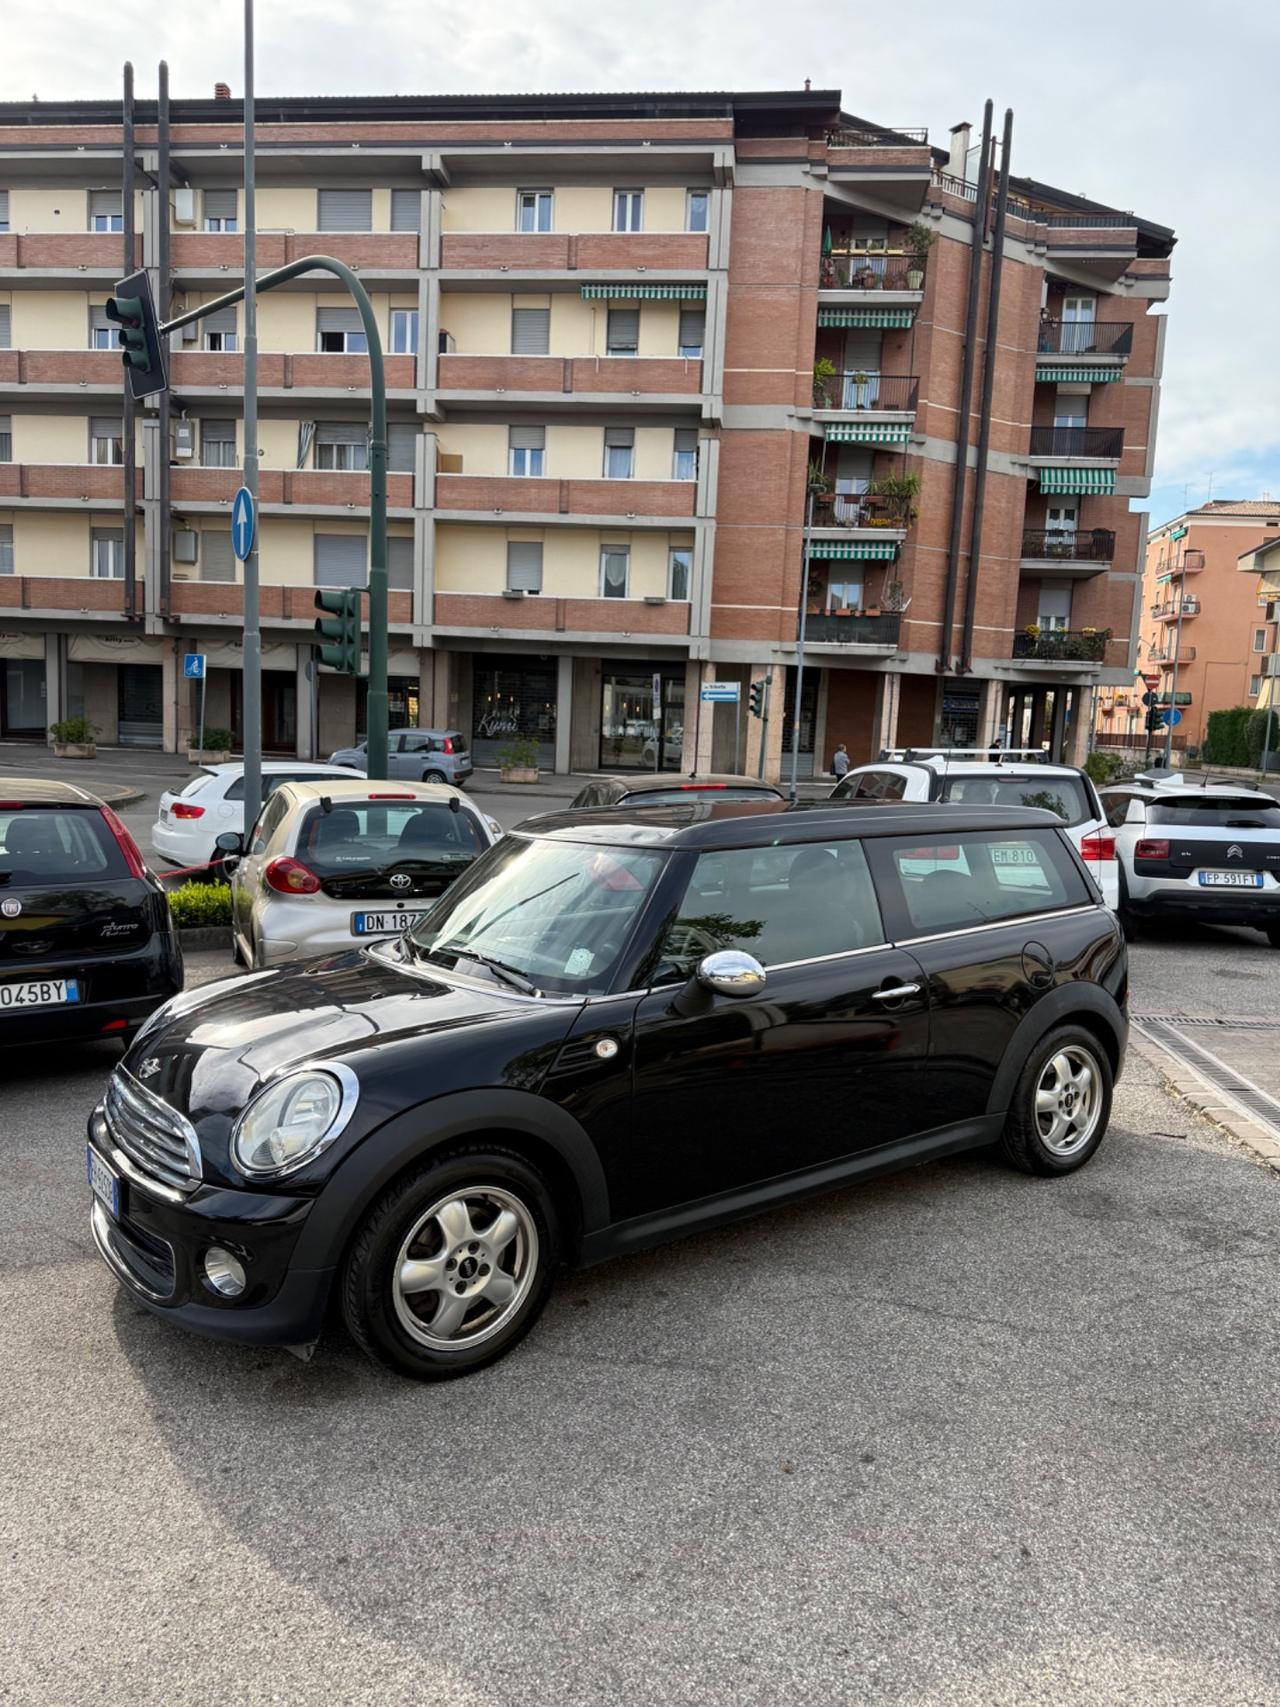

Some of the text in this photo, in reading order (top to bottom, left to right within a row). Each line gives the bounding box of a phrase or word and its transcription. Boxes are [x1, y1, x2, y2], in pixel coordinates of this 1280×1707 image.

[1207, 873, 1255, 885] FP 591FT
[366, 914, 385, 930] DN
[0, 981, 64, 1006] 045BY
